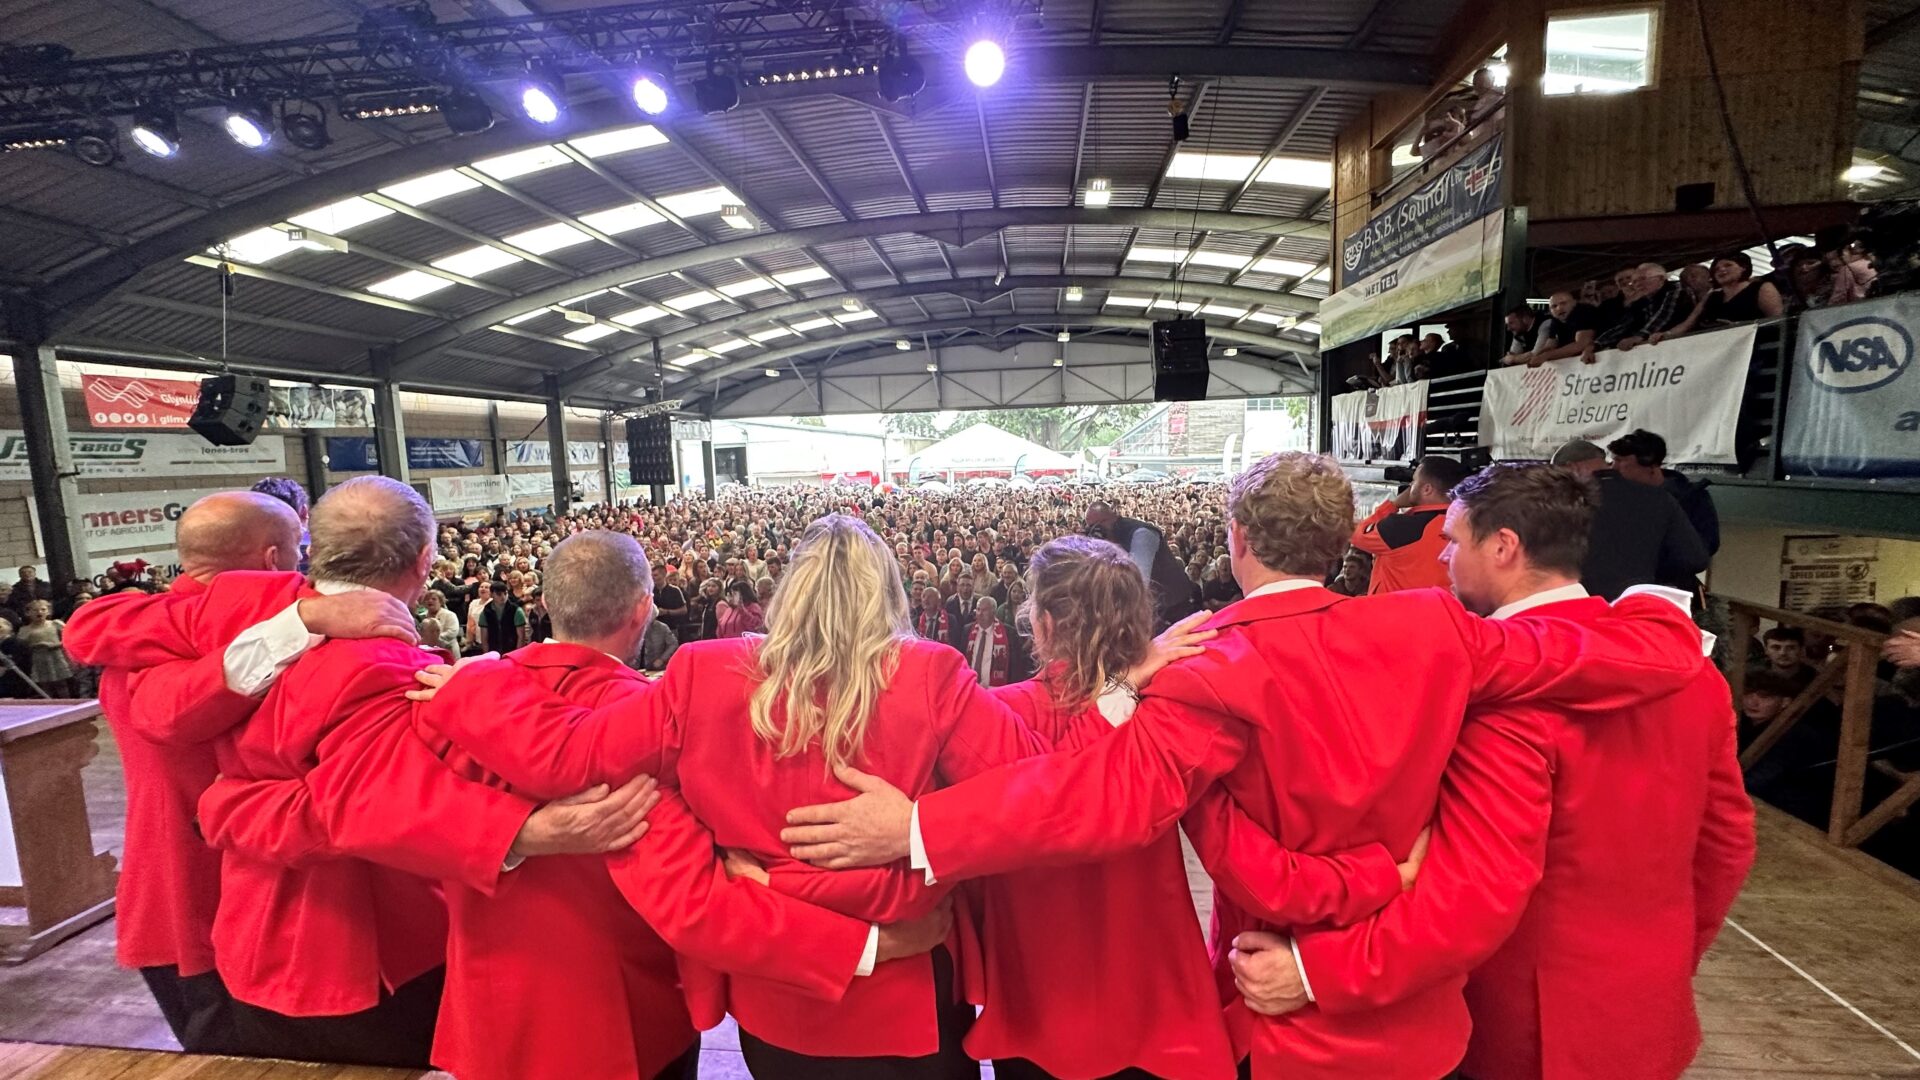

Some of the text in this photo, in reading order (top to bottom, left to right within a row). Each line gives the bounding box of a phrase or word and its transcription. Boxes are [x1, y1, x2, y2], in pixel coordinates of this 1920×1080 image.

[1364, 216, 1394, 250] B.S.B.
[1397, 170, 1450, 231] (Sound)
[1817, 336, 1900, 374] NSA
[1562, 361, 1685, 397] Streamline
[1556, 401, 1629, 425] Leisure
[110, 524, 165, 536] AGRICULTURE
